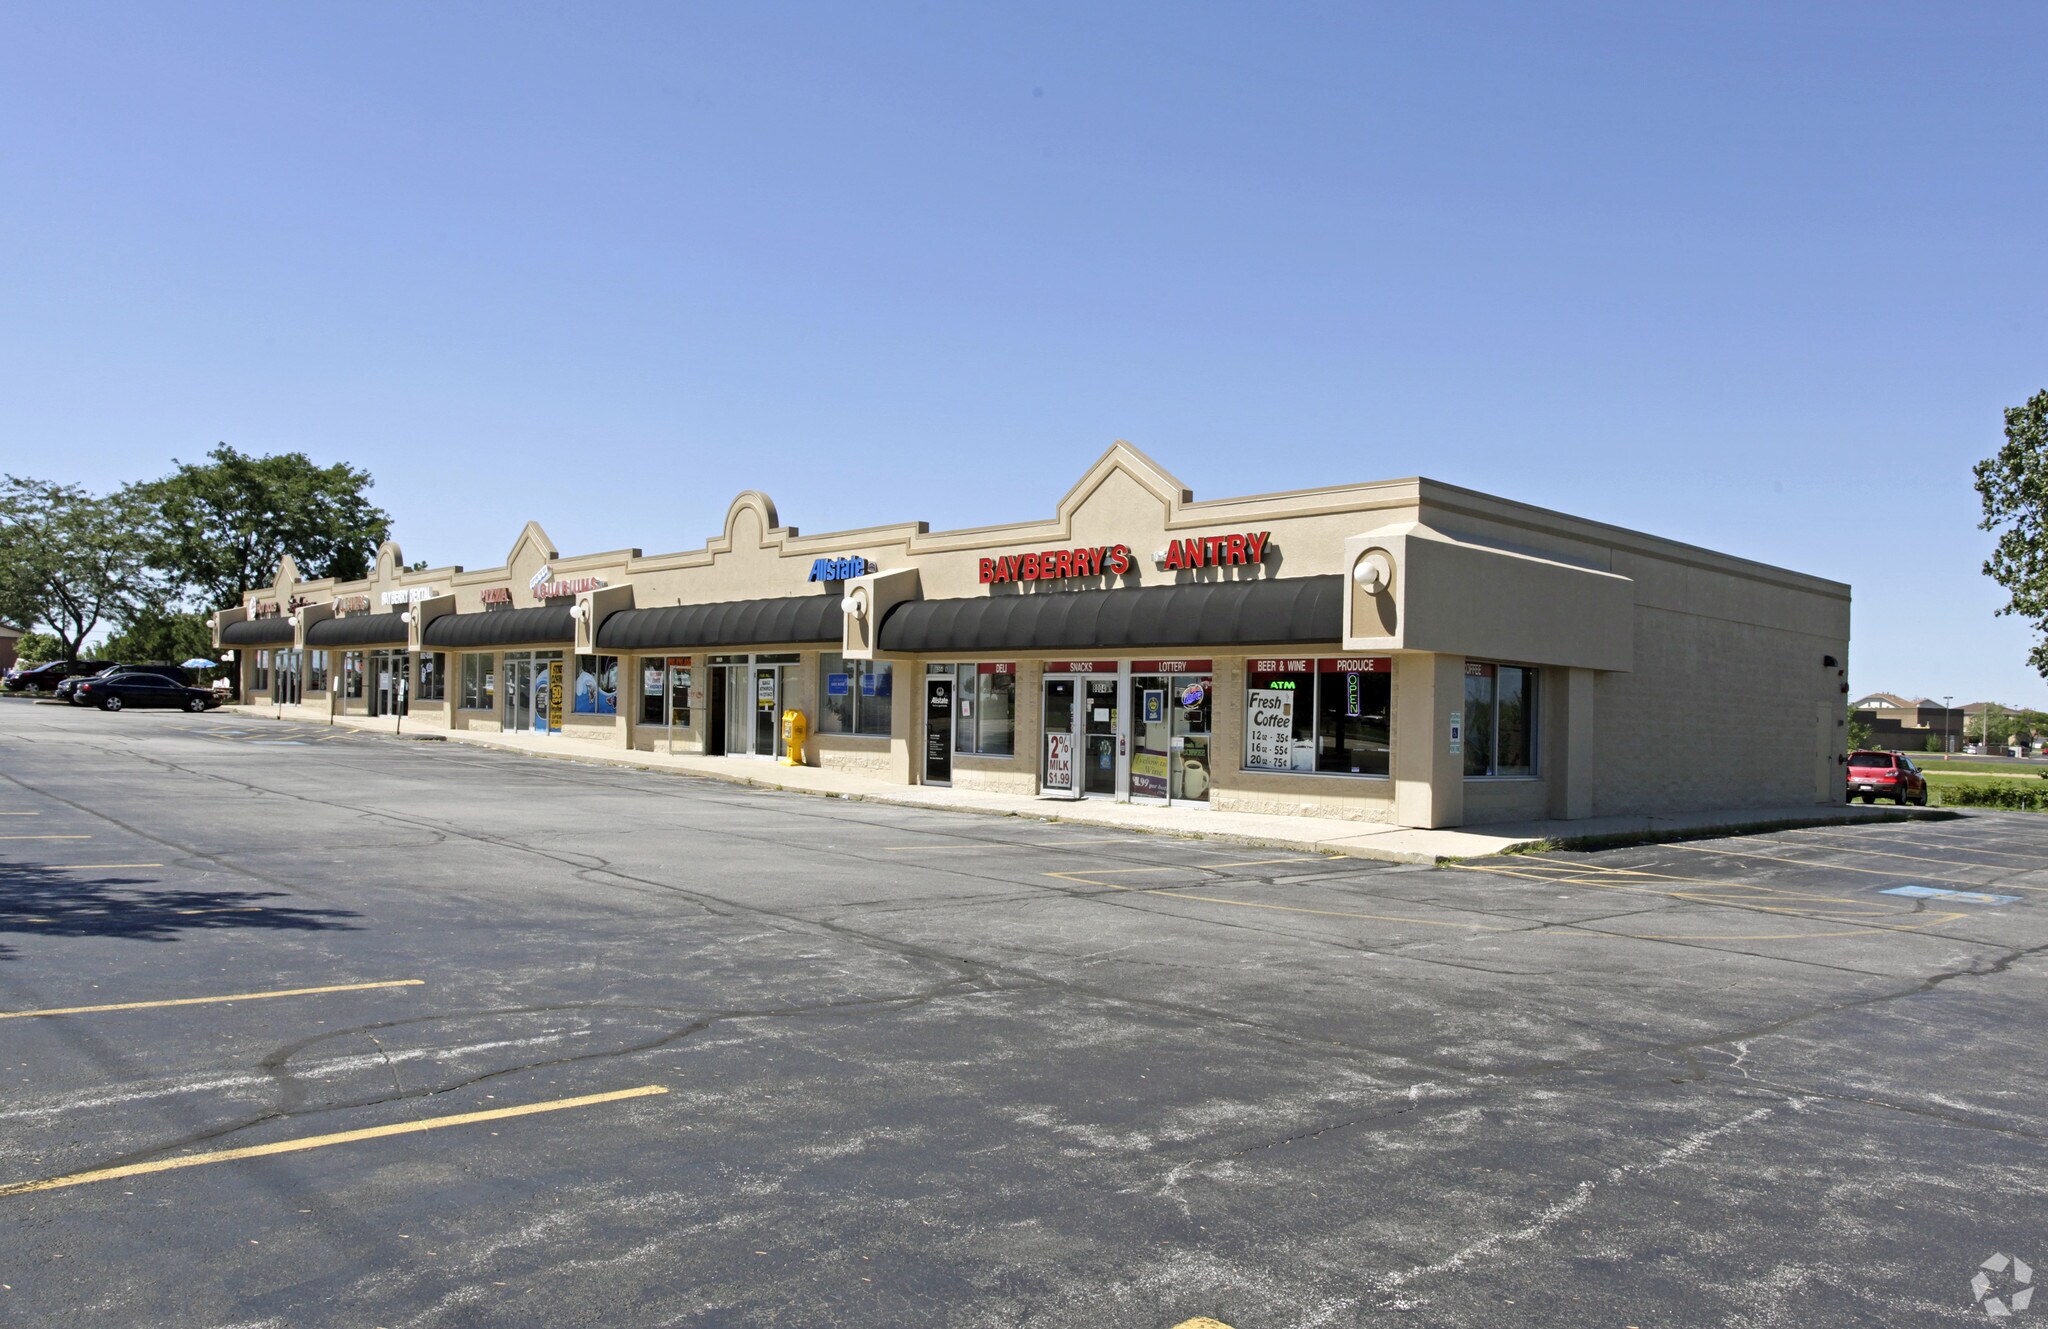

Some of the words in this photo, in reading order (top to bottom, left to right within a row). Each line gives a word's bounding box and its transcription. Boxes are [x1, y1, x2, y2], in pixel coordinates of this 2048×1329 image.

[808, 555, 866, 582] Allstate
[533, 577, 598, 599] AQUARIUMS
[480, 588, 509, 602] PIZZA
[996, 664, 1007, 673] DELI
[1070, 662, 1092, 672] SNACKS
[1158, 661, 1187, 672] LOTTERY
[1257, 660, 1276, 671] BEER
[1279, 660, 1285, 671] &
[1287, 660, 1306, 671] WINE
[1337, 660, 1374, 671] PRODUCE
[1465, 664, 1482, 675] OFFEE
[1270, 681, 1296, 689] ATM
[1349, 675, 1358, 713] OPEN
[1249, 692, 1281, 709] Fresh
[1254, 711, 1290, 728] Coffee
[1252, 731, 1261, 740] 12
[1051, 736, 1069, 758] 2%
[1251, 743, 1261, 753] 16
[1250, 755, 1261, 764] 20
[1050, 760, 1069, 771] MILK
[1049, 773, 1070, 785] $1.99
